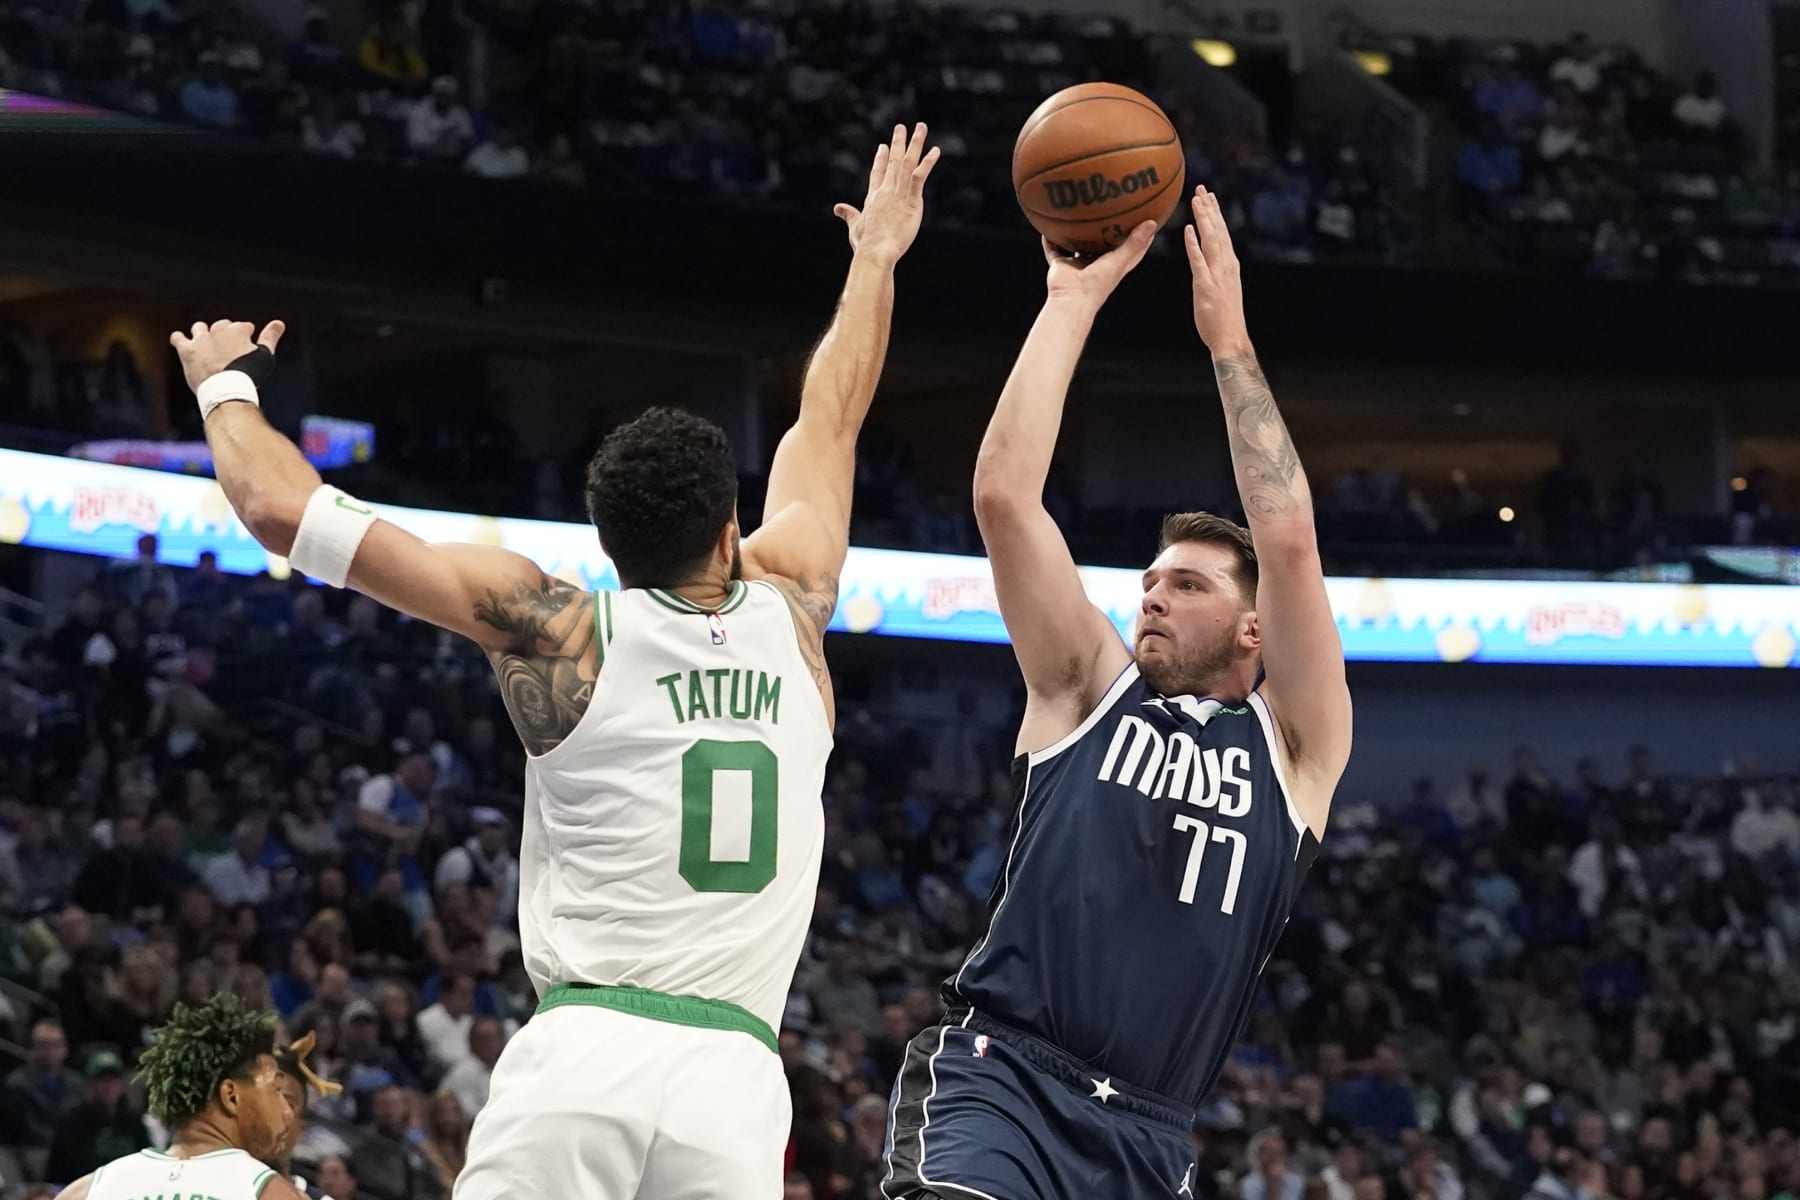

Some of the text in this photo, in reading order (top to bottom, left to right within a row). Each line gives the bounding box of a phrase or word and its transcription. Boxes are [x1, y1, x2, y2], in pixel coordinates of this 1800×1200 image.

[1042, 166, 1161, 209] Wilson
[656, 668, 782, 726] TATUM
[678, 738, 779, 894] 0
[1097, 714, 1252, 818] MAVS
[1172, 813, 1248, 916] 77
